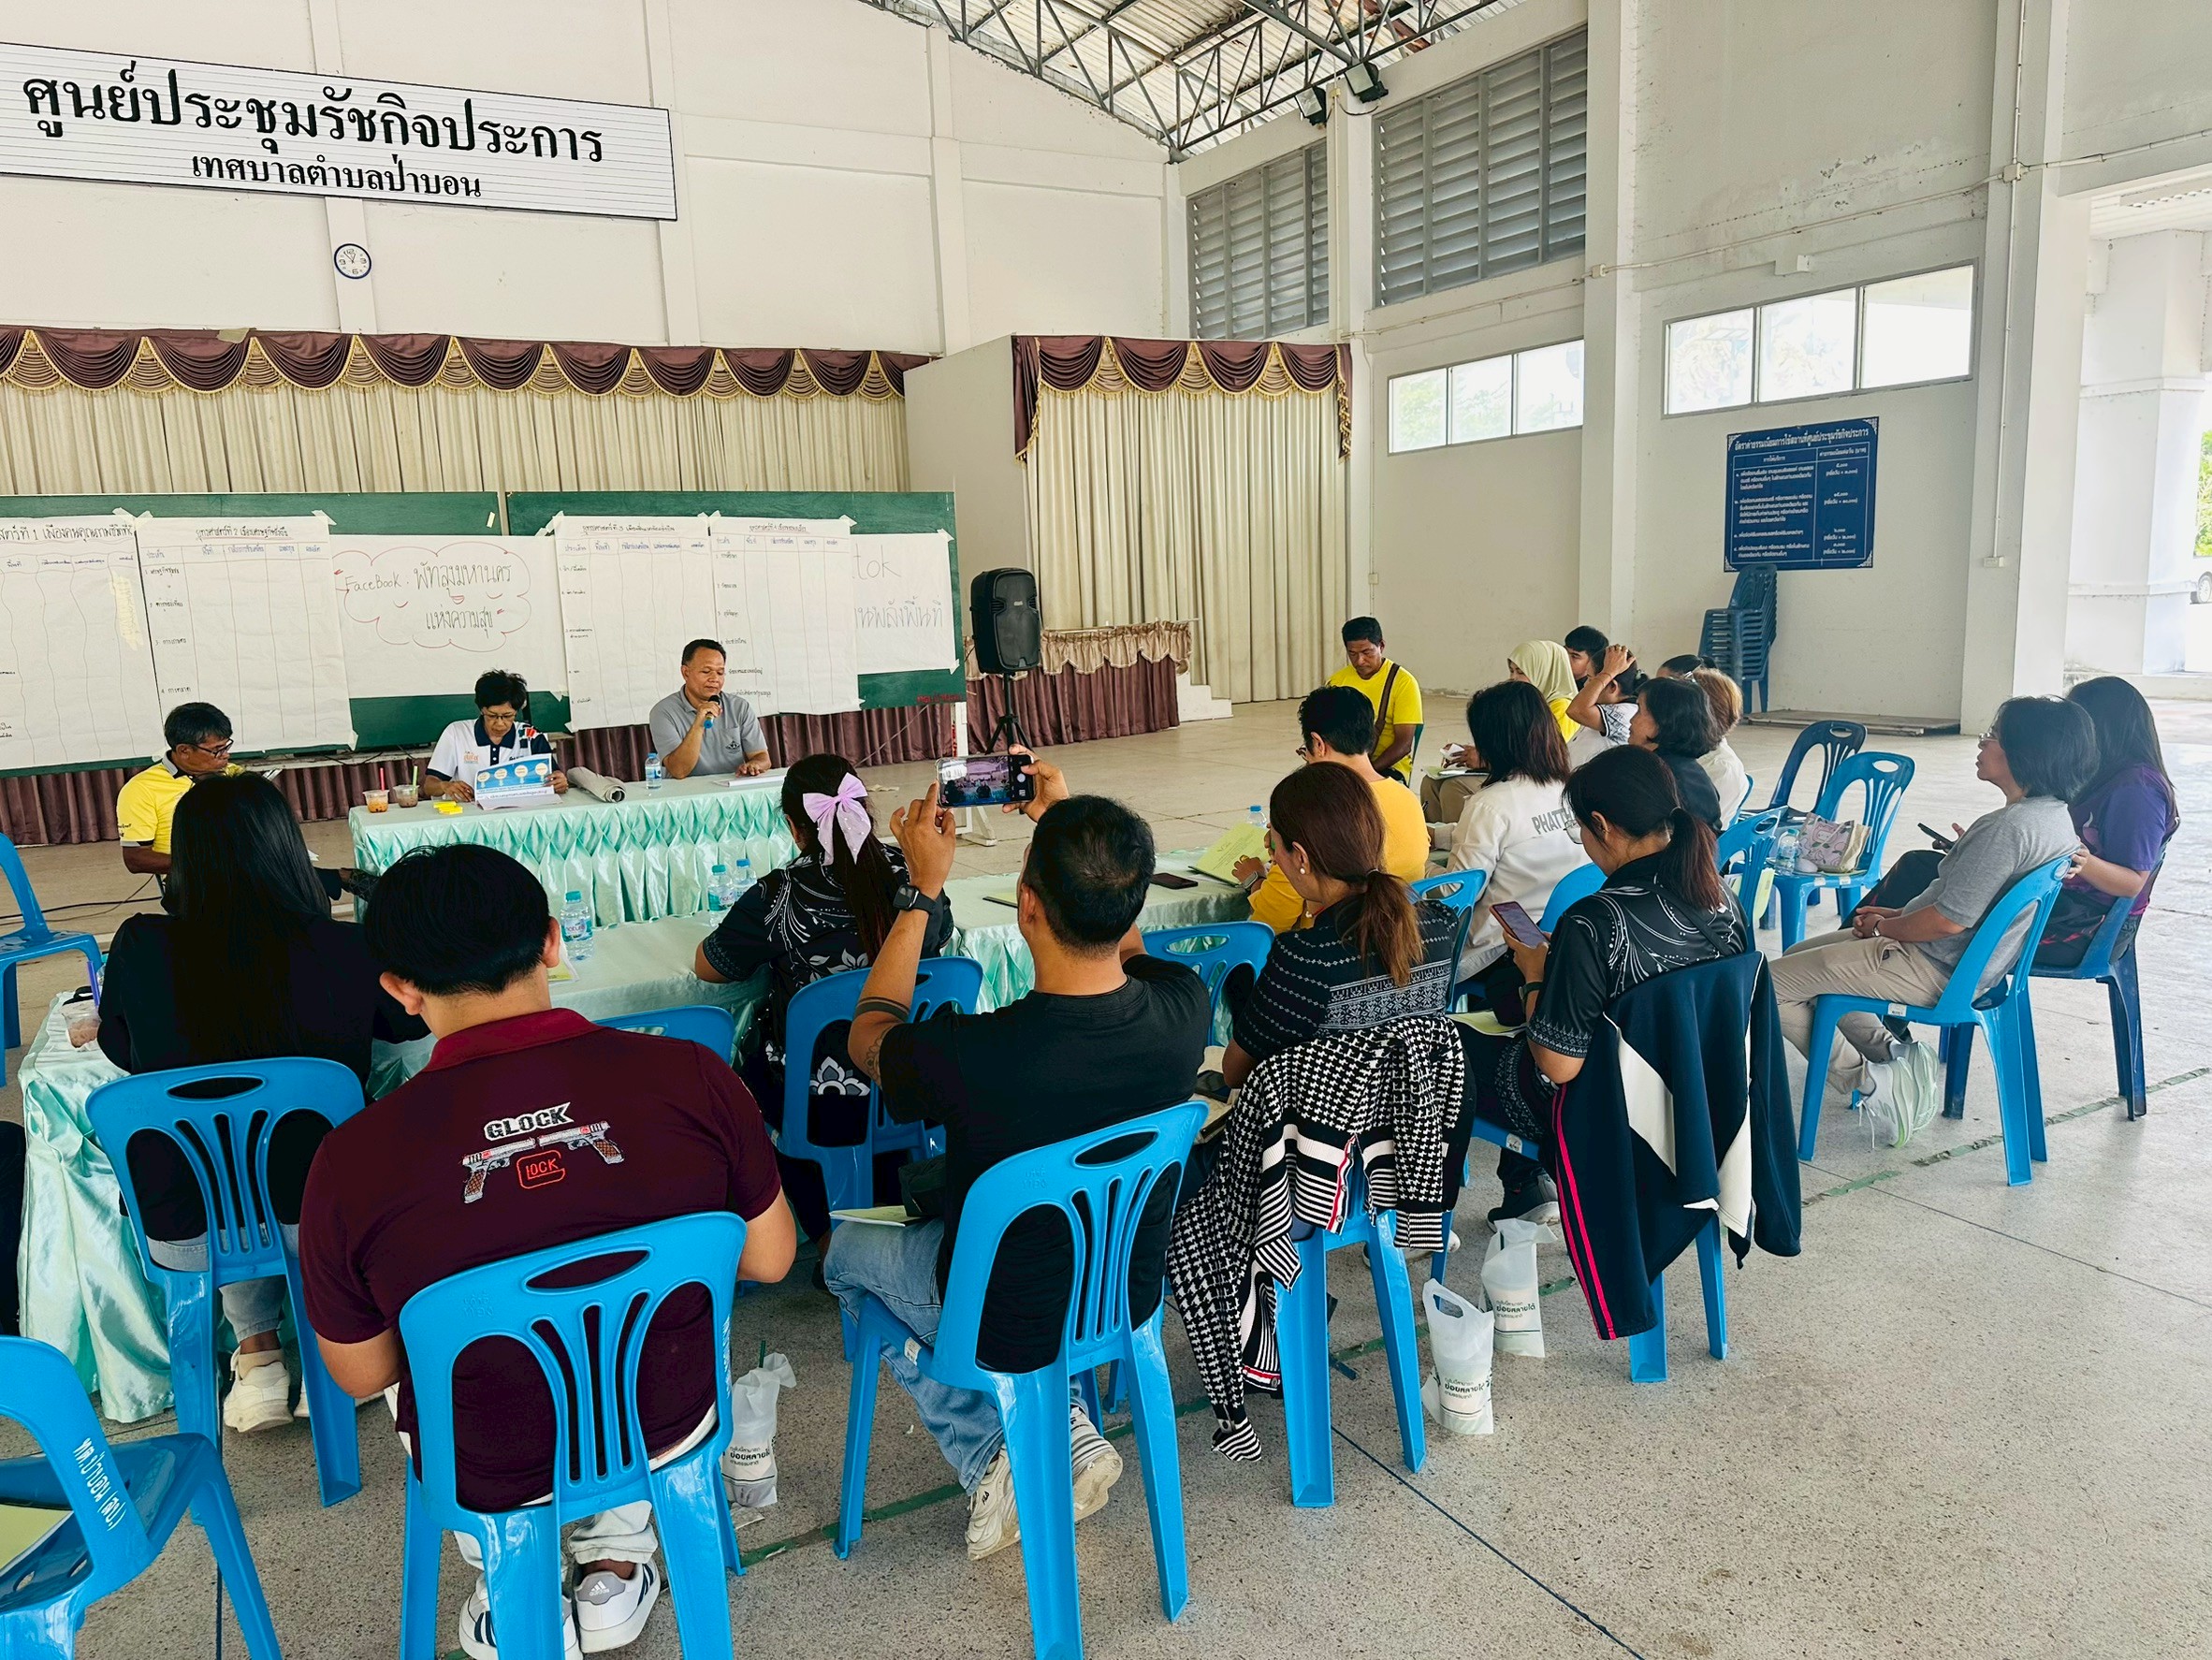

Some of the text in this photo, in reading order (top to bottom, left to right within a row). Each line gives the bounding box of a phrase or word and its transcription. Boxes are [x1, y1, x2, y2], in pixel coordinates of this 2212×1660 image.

[22, 61, 604, 163] ศูนย์ประชุมรัชกิจประการ
[192, 153, 482, 198] เทศบาลตำบลป่าบอน
[414, 561, 512, 597] พัทลุงมหานคร
[426, 604, 494, 638] แห่งความสุข
[485, 1103, 573, 1141] GLOCK
[1496, 1303, 1535, 1313] ย่อยสลายได้
